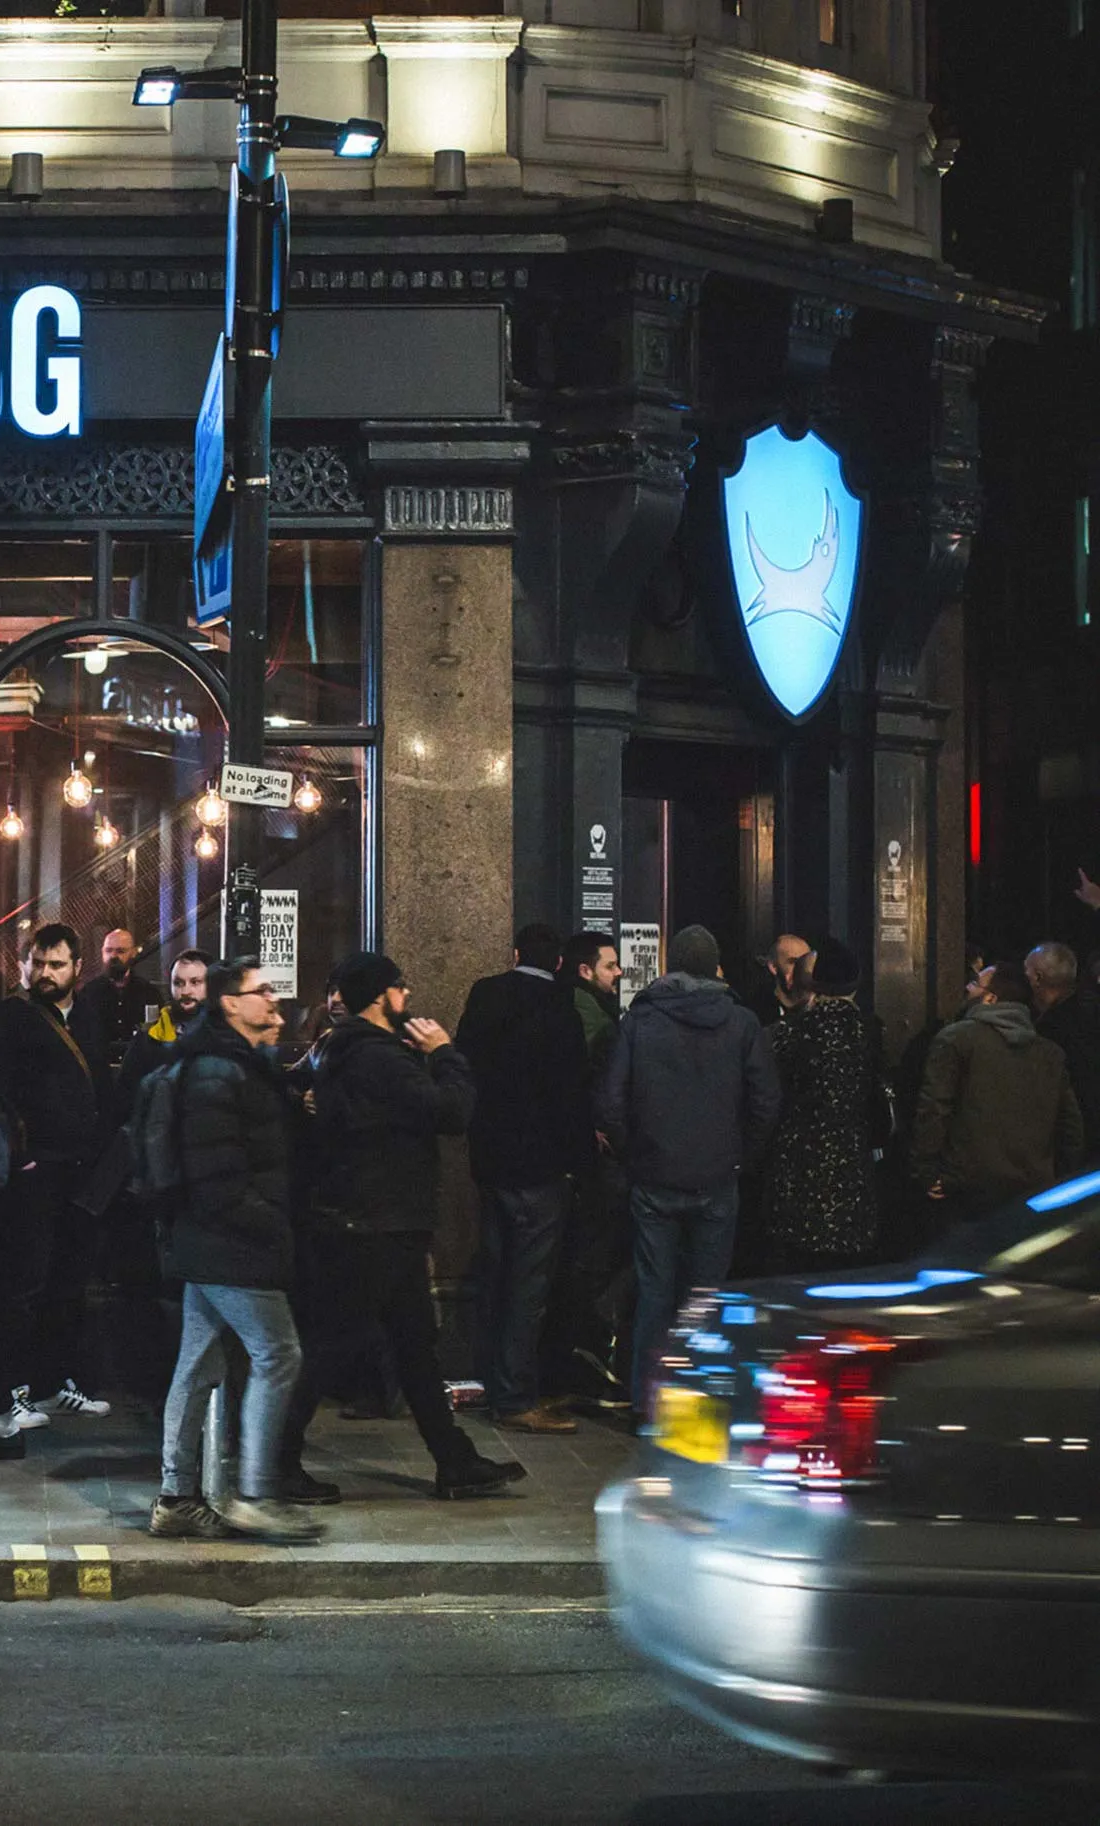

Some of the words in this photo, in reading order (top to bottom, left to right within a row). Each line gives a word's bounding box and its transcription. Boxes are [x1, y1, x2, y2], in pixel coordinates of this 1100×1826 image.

[227, 770, 243, 781] No
[246, 772, 288, 788] loading
[225, 785, 236, 794] at
[283, 913, 295, 924] ON
[260, 924, 294, 938] RIDAY
[271, 939, 293, 953] 9TH
[261, 953, 279, 963] 2.00
[281, 953, 294, 963] PM
